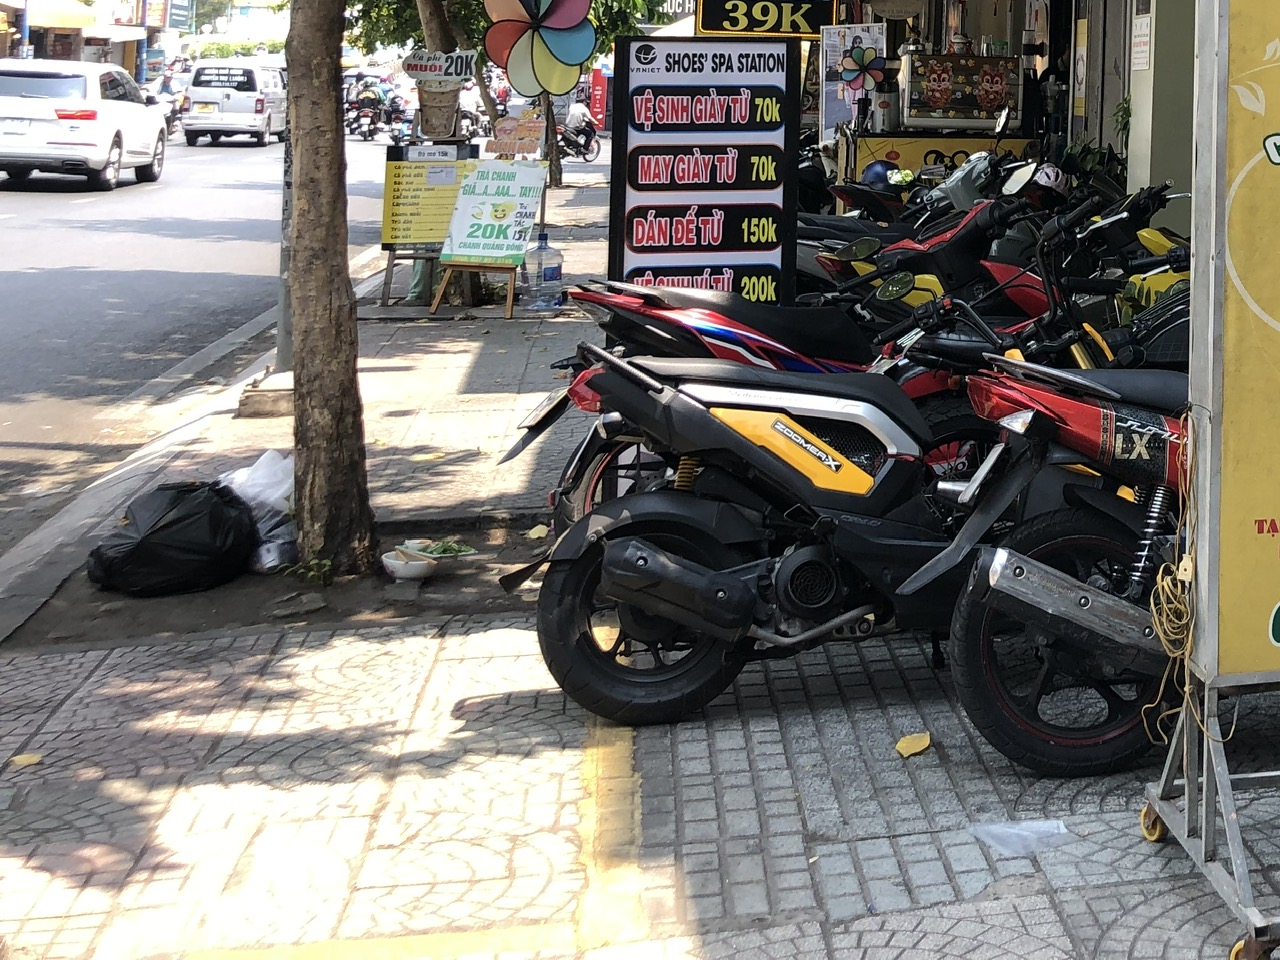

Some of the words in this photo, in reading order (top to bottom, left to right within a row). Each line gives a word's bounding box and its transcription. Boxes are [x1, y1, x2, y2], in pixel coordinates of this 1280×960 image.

[723, 1, 812, 32] 39K
[444, 55, 474, 76] 20K
[711, 53, 734, 73] SPA
[737, 53, 785, 73] STATION
[633, 89, 654, 131] VỆ
[656, 95, 691, 123] SINH
[693, 88, 729, 124] GIÀY
[730, 88, 751, 123] TỪ
[755, 97, 781, 122] 70k
[638, 155, 673, 184] MAY
[675, 148, 712, 184] GIÀY
[715, 148, 738, 183] TỪ
[751, 156, 776, 182] 70k
[466, 223, 513, 240] 20K
[633, 210, 671, 246] DÁN
[672, 206, 698, 246] ĐẾ
[699, 210, 724, 245] TỪ
[742, 218, 777, 243] 150k
[741, 276, 776, 302] 200k
[1115, 433, 1152, 459] LX
